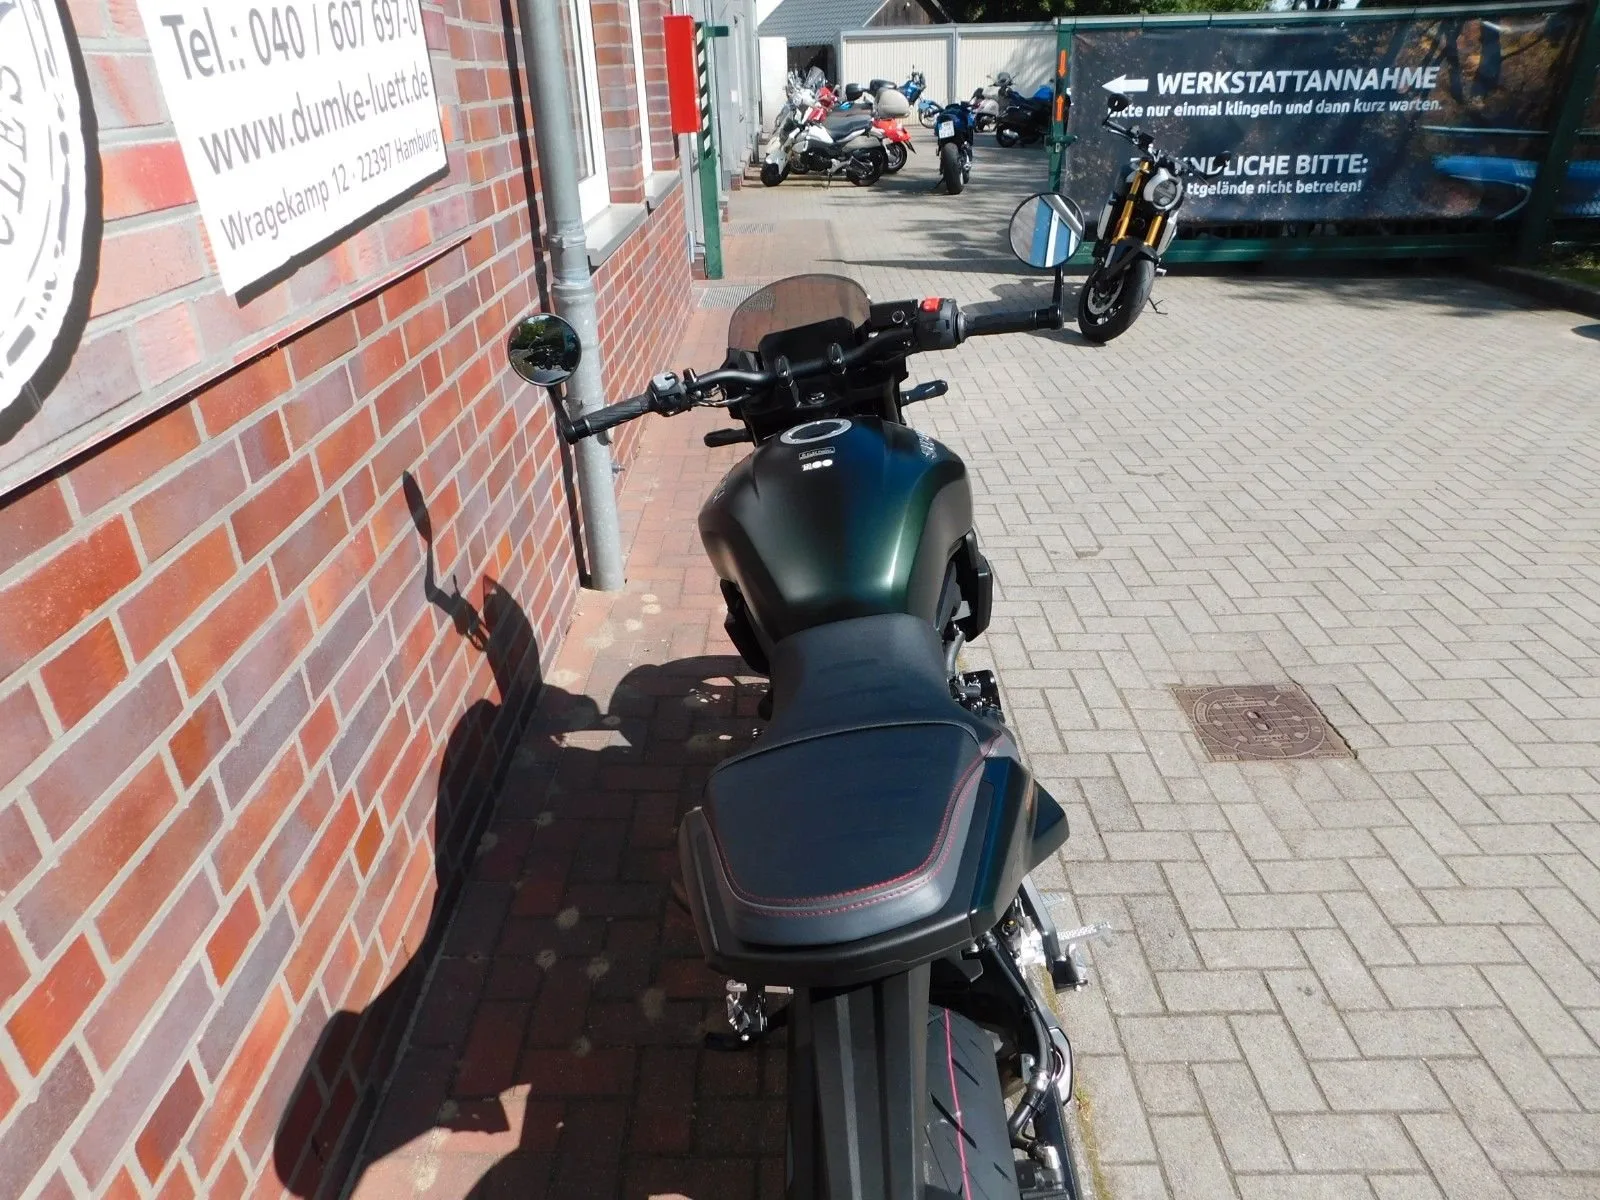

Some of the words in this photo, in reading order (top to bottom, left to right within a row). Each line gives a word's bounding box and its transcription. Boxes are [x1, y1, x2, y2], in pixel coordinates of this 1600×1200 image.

[160, 6, 246, 80] Tel.:
[249, 4, 306, 67] 040
[312, 3, 320, 56] /
[328, 1, 364, 52] 607
[371, 0, 417, 42] 697-0
[1157, 66, 1439, 95] WERKSTATTANNAHME
[198, 61, 430, 175] www.dumke-luett.de
[1146, 105, 1172, 117] nur
[1173, 101, 1222, 117] einmal
[1225, 100, 1282, 118] klingeln
[1285, 100, 1313, 115] und
[1315, 99, 1350, 114] dann
[1353, 98, 1386, 113] kurz
[1389, 98, 1442, 112] warten.
[1295, 153, 1369, 175] BITTE:
[220, 180, 330, 251] Wragekamp
[332, 164, 350, 194] 12
[357, 142, 392, 183] 22397
[394, 128, 439, 163] Hamburg
[1257, 181, 1293, 195] nicht
[1295, 179, 1362, 194] betreten!
